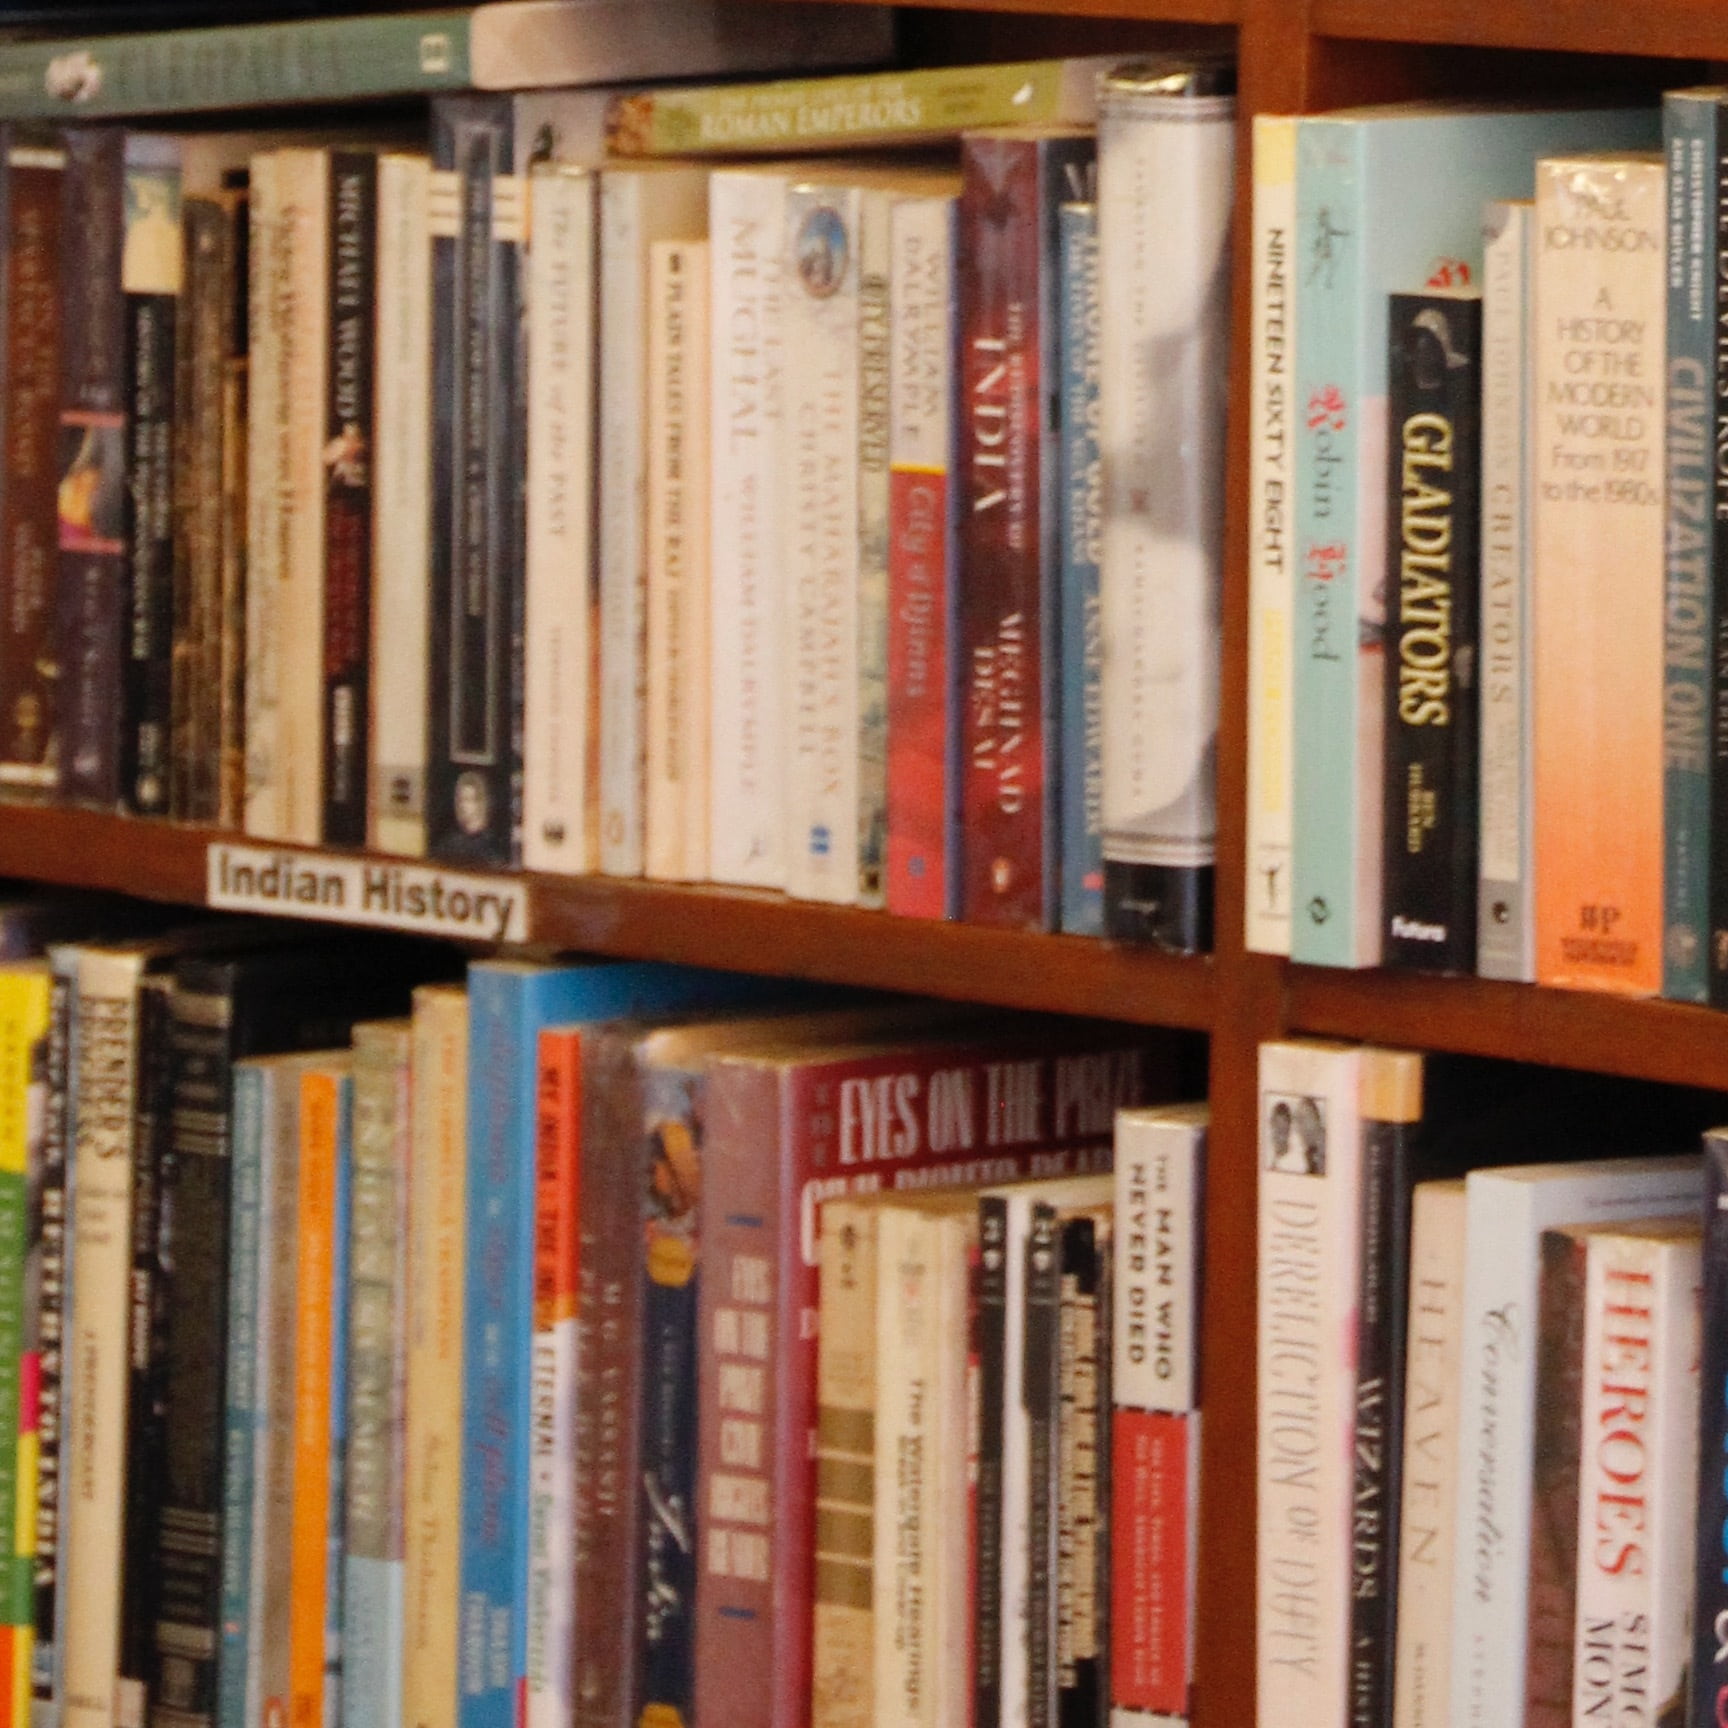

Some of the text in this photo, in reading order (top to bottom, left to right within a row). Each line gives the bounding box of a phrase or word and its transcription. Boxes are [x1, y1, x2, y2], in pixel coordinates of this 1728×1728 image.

[1264, 228, 1286, 576] NINETEEN SIXTY EIGHT
[1398, 413, 1454, 728] GLADIATORS
[218, 850, 514, 941] Indian History
[1128, 1162, 1149, 1366] NEVER DIED
[1154, 1206, 1176, 1285] MAN
[1154, 1301, 1175, 1381] WHO
[1597, 1266, 1653, 1578] HEROES
